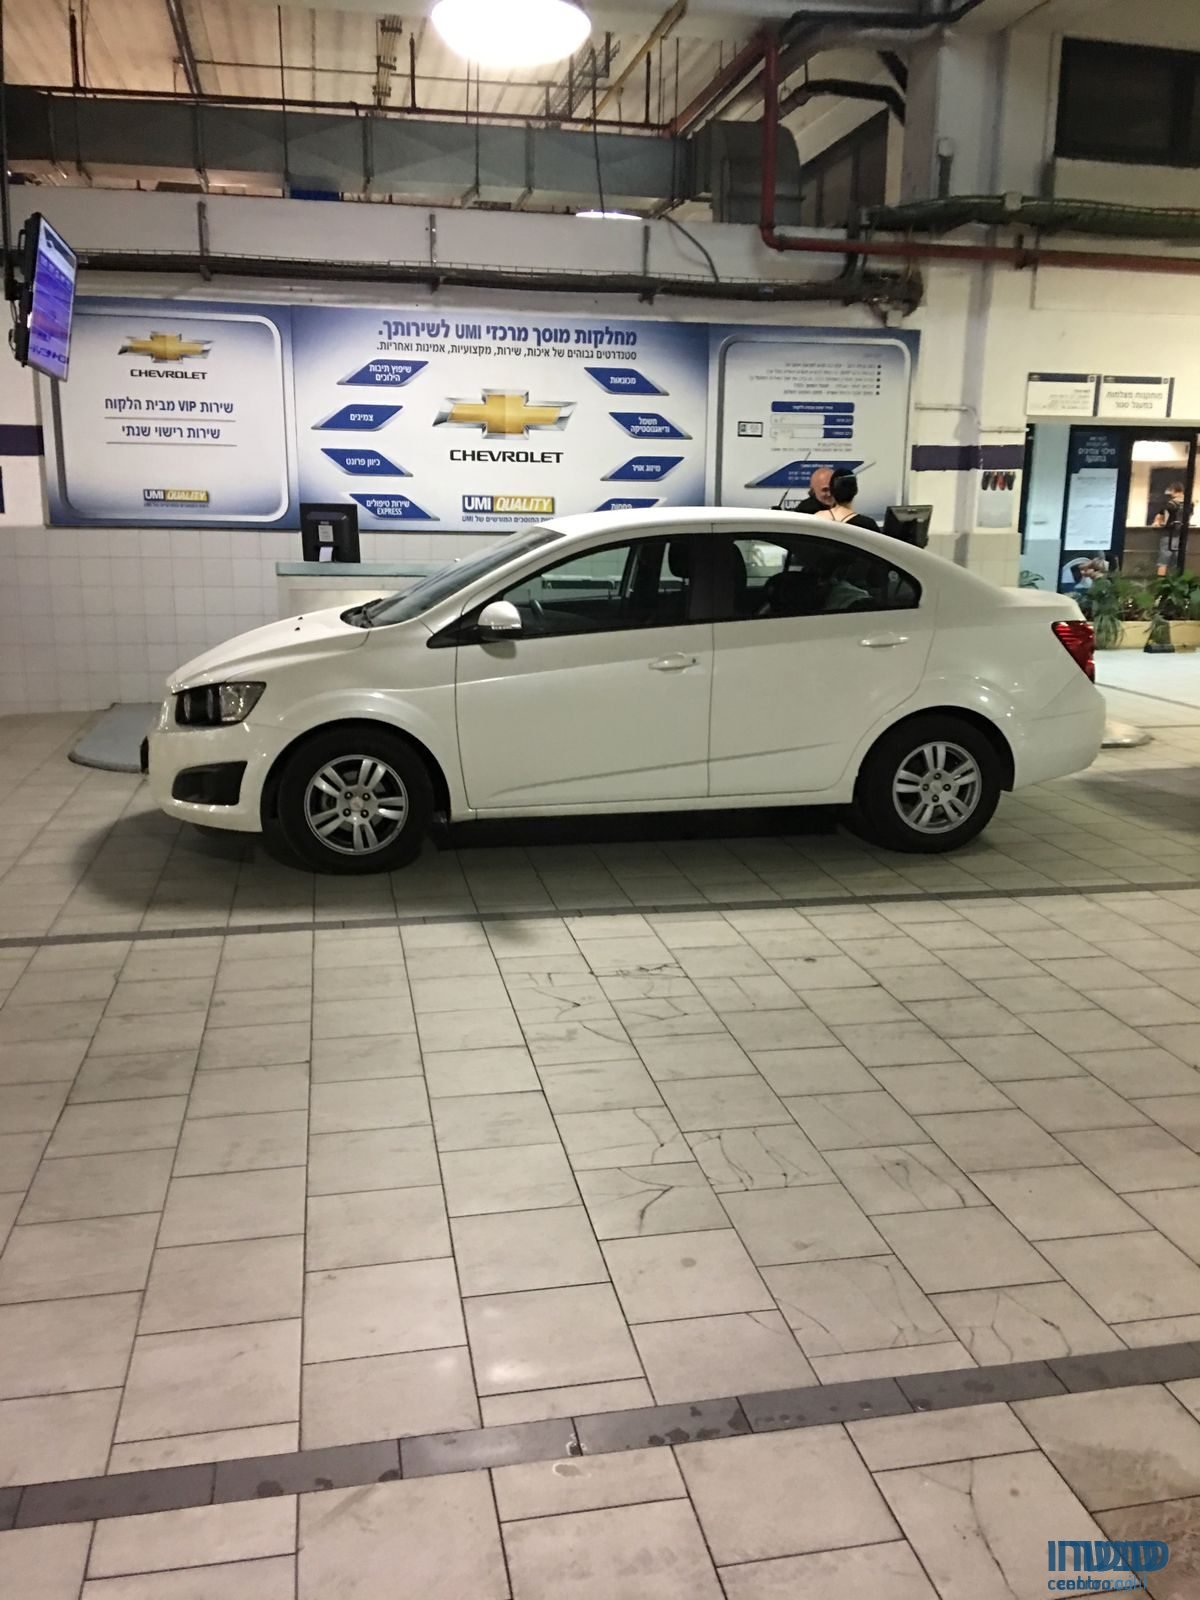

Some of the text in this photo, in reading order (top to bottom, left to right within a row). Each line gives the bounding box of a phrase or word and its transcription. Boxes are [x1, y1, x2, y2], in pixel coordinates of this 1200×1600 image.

[378, 319, 637, 348] מחלקות מוסך מרכזי UMI לשירותך.
[377, 341, 637, 360] סטנדרטים גבוהים של איכות, שירות, מקצועיות, אמינות ואחריות.
[129, 368, 208, 380] CHEVROLET
[368, 364, 412, 374] שיפוץ תיבות
[375, 372, 401, 382] הילוכים
[104, 396, 234, 414] שירות VIP מבית הלקוח
[349, 413, 374, 422] צמיגים
[121, 425, 221, 439] שירות רישוי שנתי
[345, 458, 366, 466] פרונט
[449, 449, 564, 463] CHEVROLET
[144, 490, 165, 500] UMI
[464, 496, 552, 512] UMI QUALITY
[376, 507, 403, 516] EXPRESS
